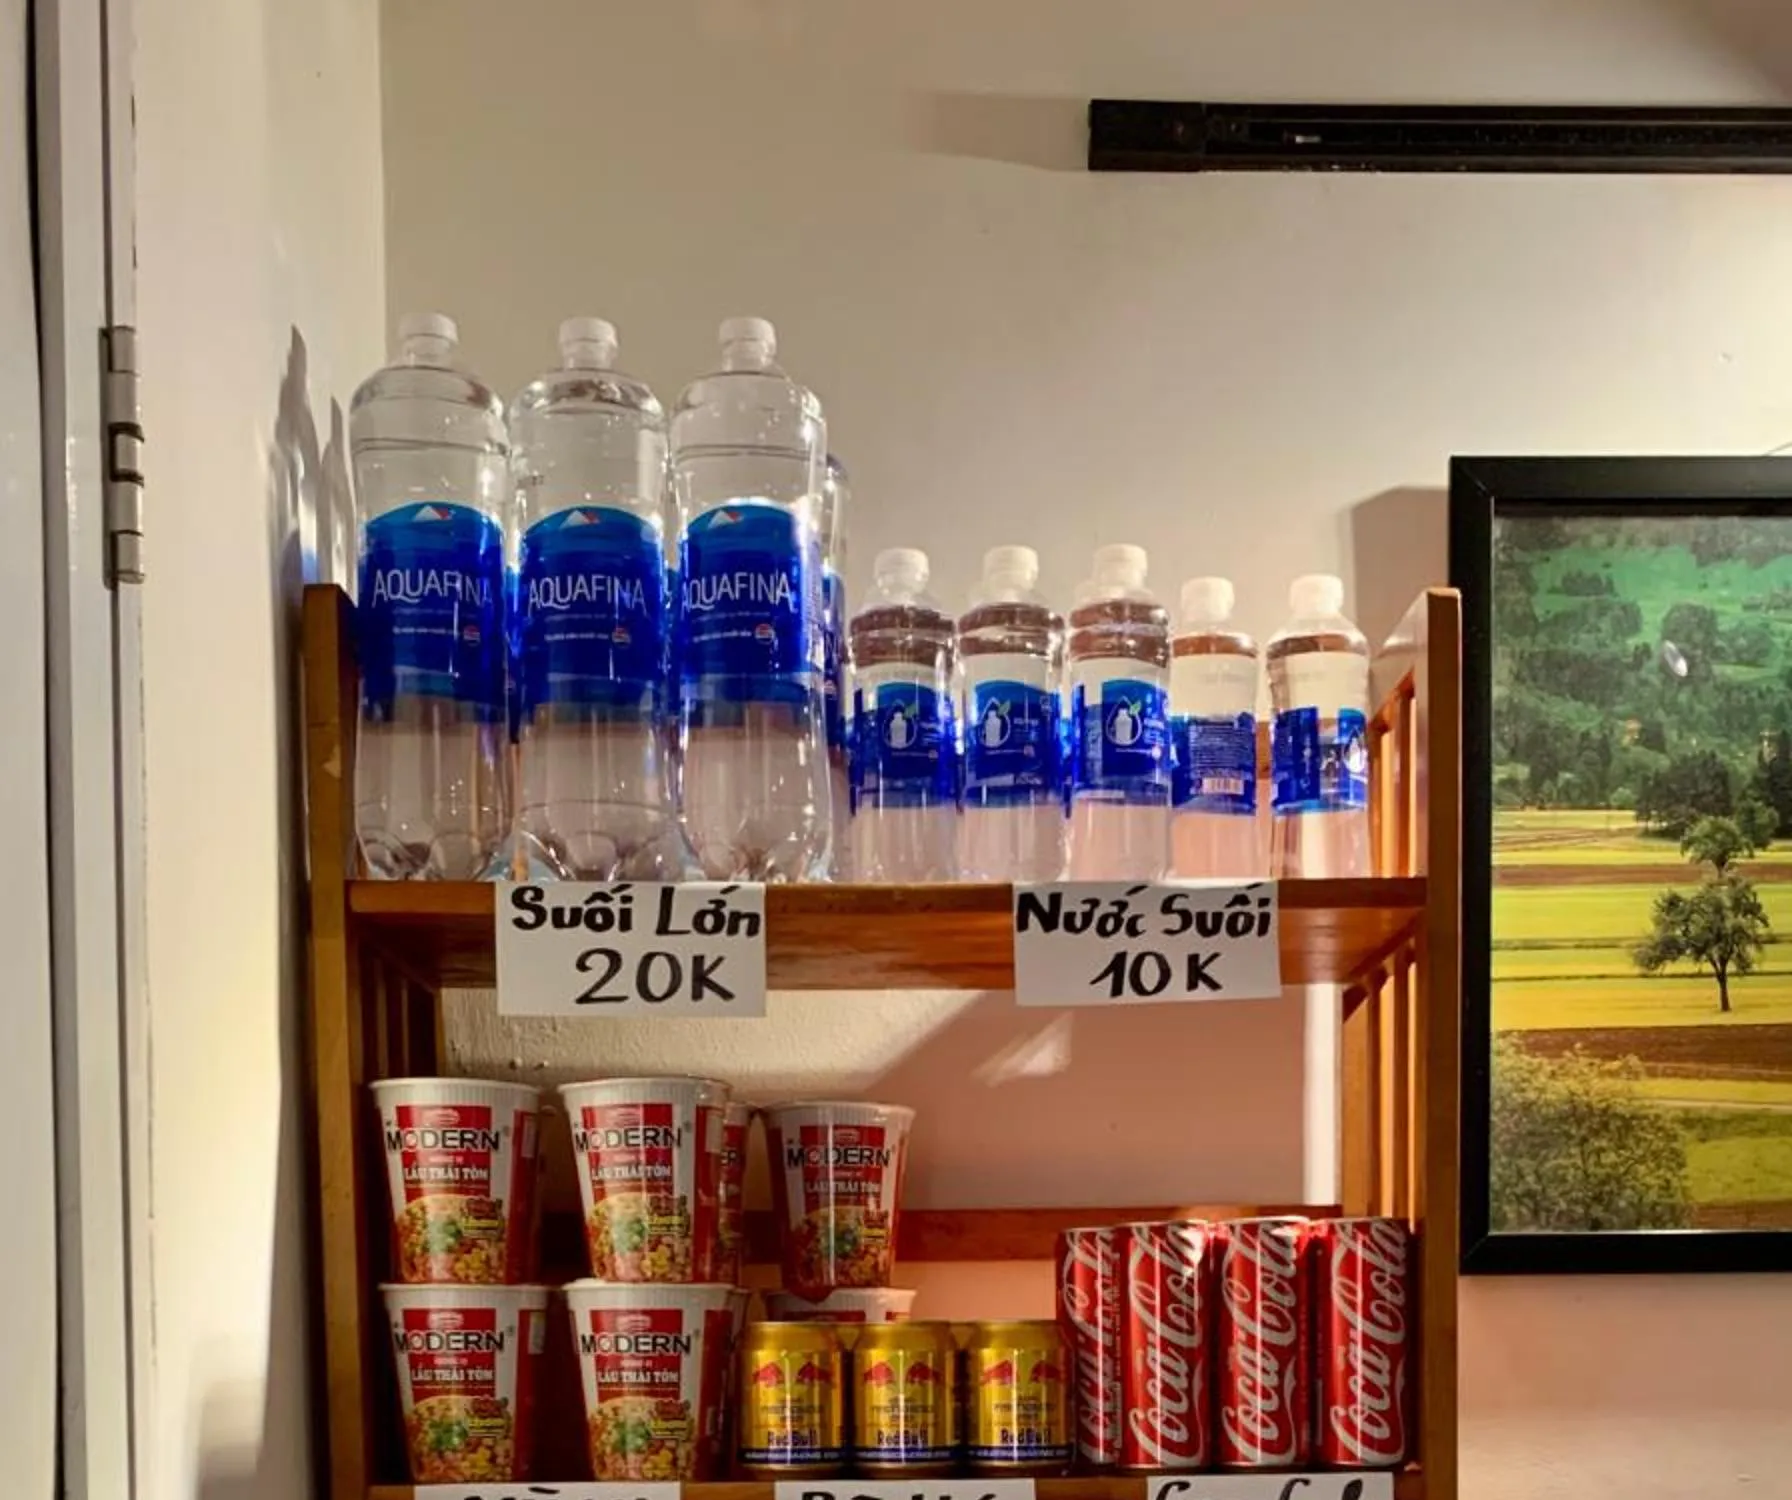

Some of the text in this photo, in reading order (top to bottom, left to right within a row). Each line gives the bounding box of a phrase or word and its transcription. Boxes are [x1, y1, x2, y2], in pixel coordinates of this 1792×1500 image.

[371, 569, 494, 608] AQUAFINA
[527, 573, 649, 618] AQUAFINA
[680, 569, 798, 620] AQUAFINA
[511, 883, 761, 937] Suối Lớn
[1016, 883, 1272, 938] Nước Suối
[575, 948, 735, 1005] 20K
[387, 1129, 500, 1151] MODERN
[575, 1126, 682, 1152] MODERN
[787, 1147, 890, 1168] MODERN
[395, 1331, 504, 1353] MODERN
[581, 1334, 691, 1355] MODERN
[1128, 1222, 1202, 1466] Coca-Cola
[1222, 1221, 1297, 1466] Coca-Cola
[1330, 1221, 1407, 1465] Coca-Cola
